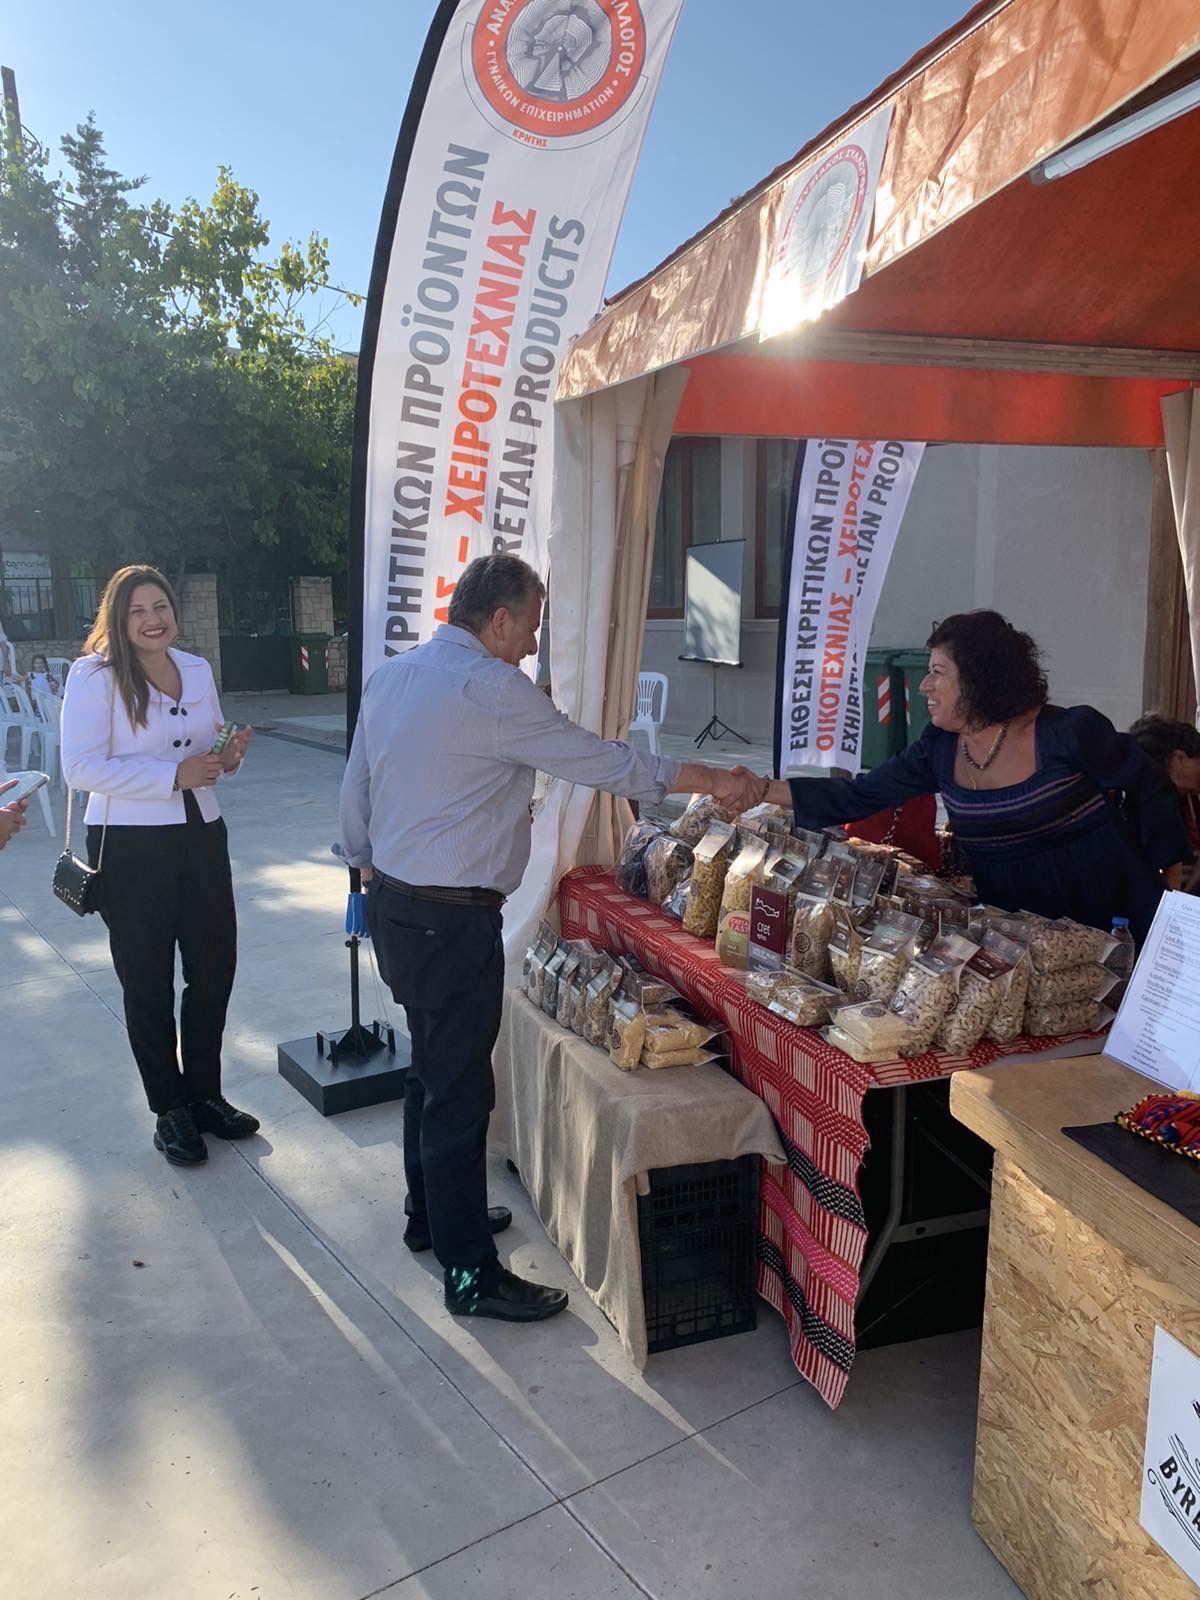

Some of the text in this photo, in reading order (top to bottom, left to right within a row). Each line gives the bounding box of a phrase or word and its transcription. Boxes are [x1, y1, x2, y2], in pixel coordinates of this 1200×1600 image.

[486, 50, 615, 122] ΓΥΝΑΙΚΩΝ ΕΠΙΧΕΙΡΗΜΑΤΙΩΝ
[511, 127, 548, 148] ΚΡΗΤΗΣ
[400, 143, 490, 429] ΠΡΟΪΟΝΤΩΝ
[509, 215, 585, 429] PRODUCTS
[444, 200, 537, 525] ΧΕΙΡΟΤΕΧΝΙΑΣ
[867, 441, 904, 506] PROD
[796, 514, 834, 650] ΚΡΗΤΙΚΩΝ
[790, 659, 814, 751] ΕΚΘΕΣΗ
[815, 592, 854, 752] ΟΙΚΟΤΕΧΝΙΑΣ
